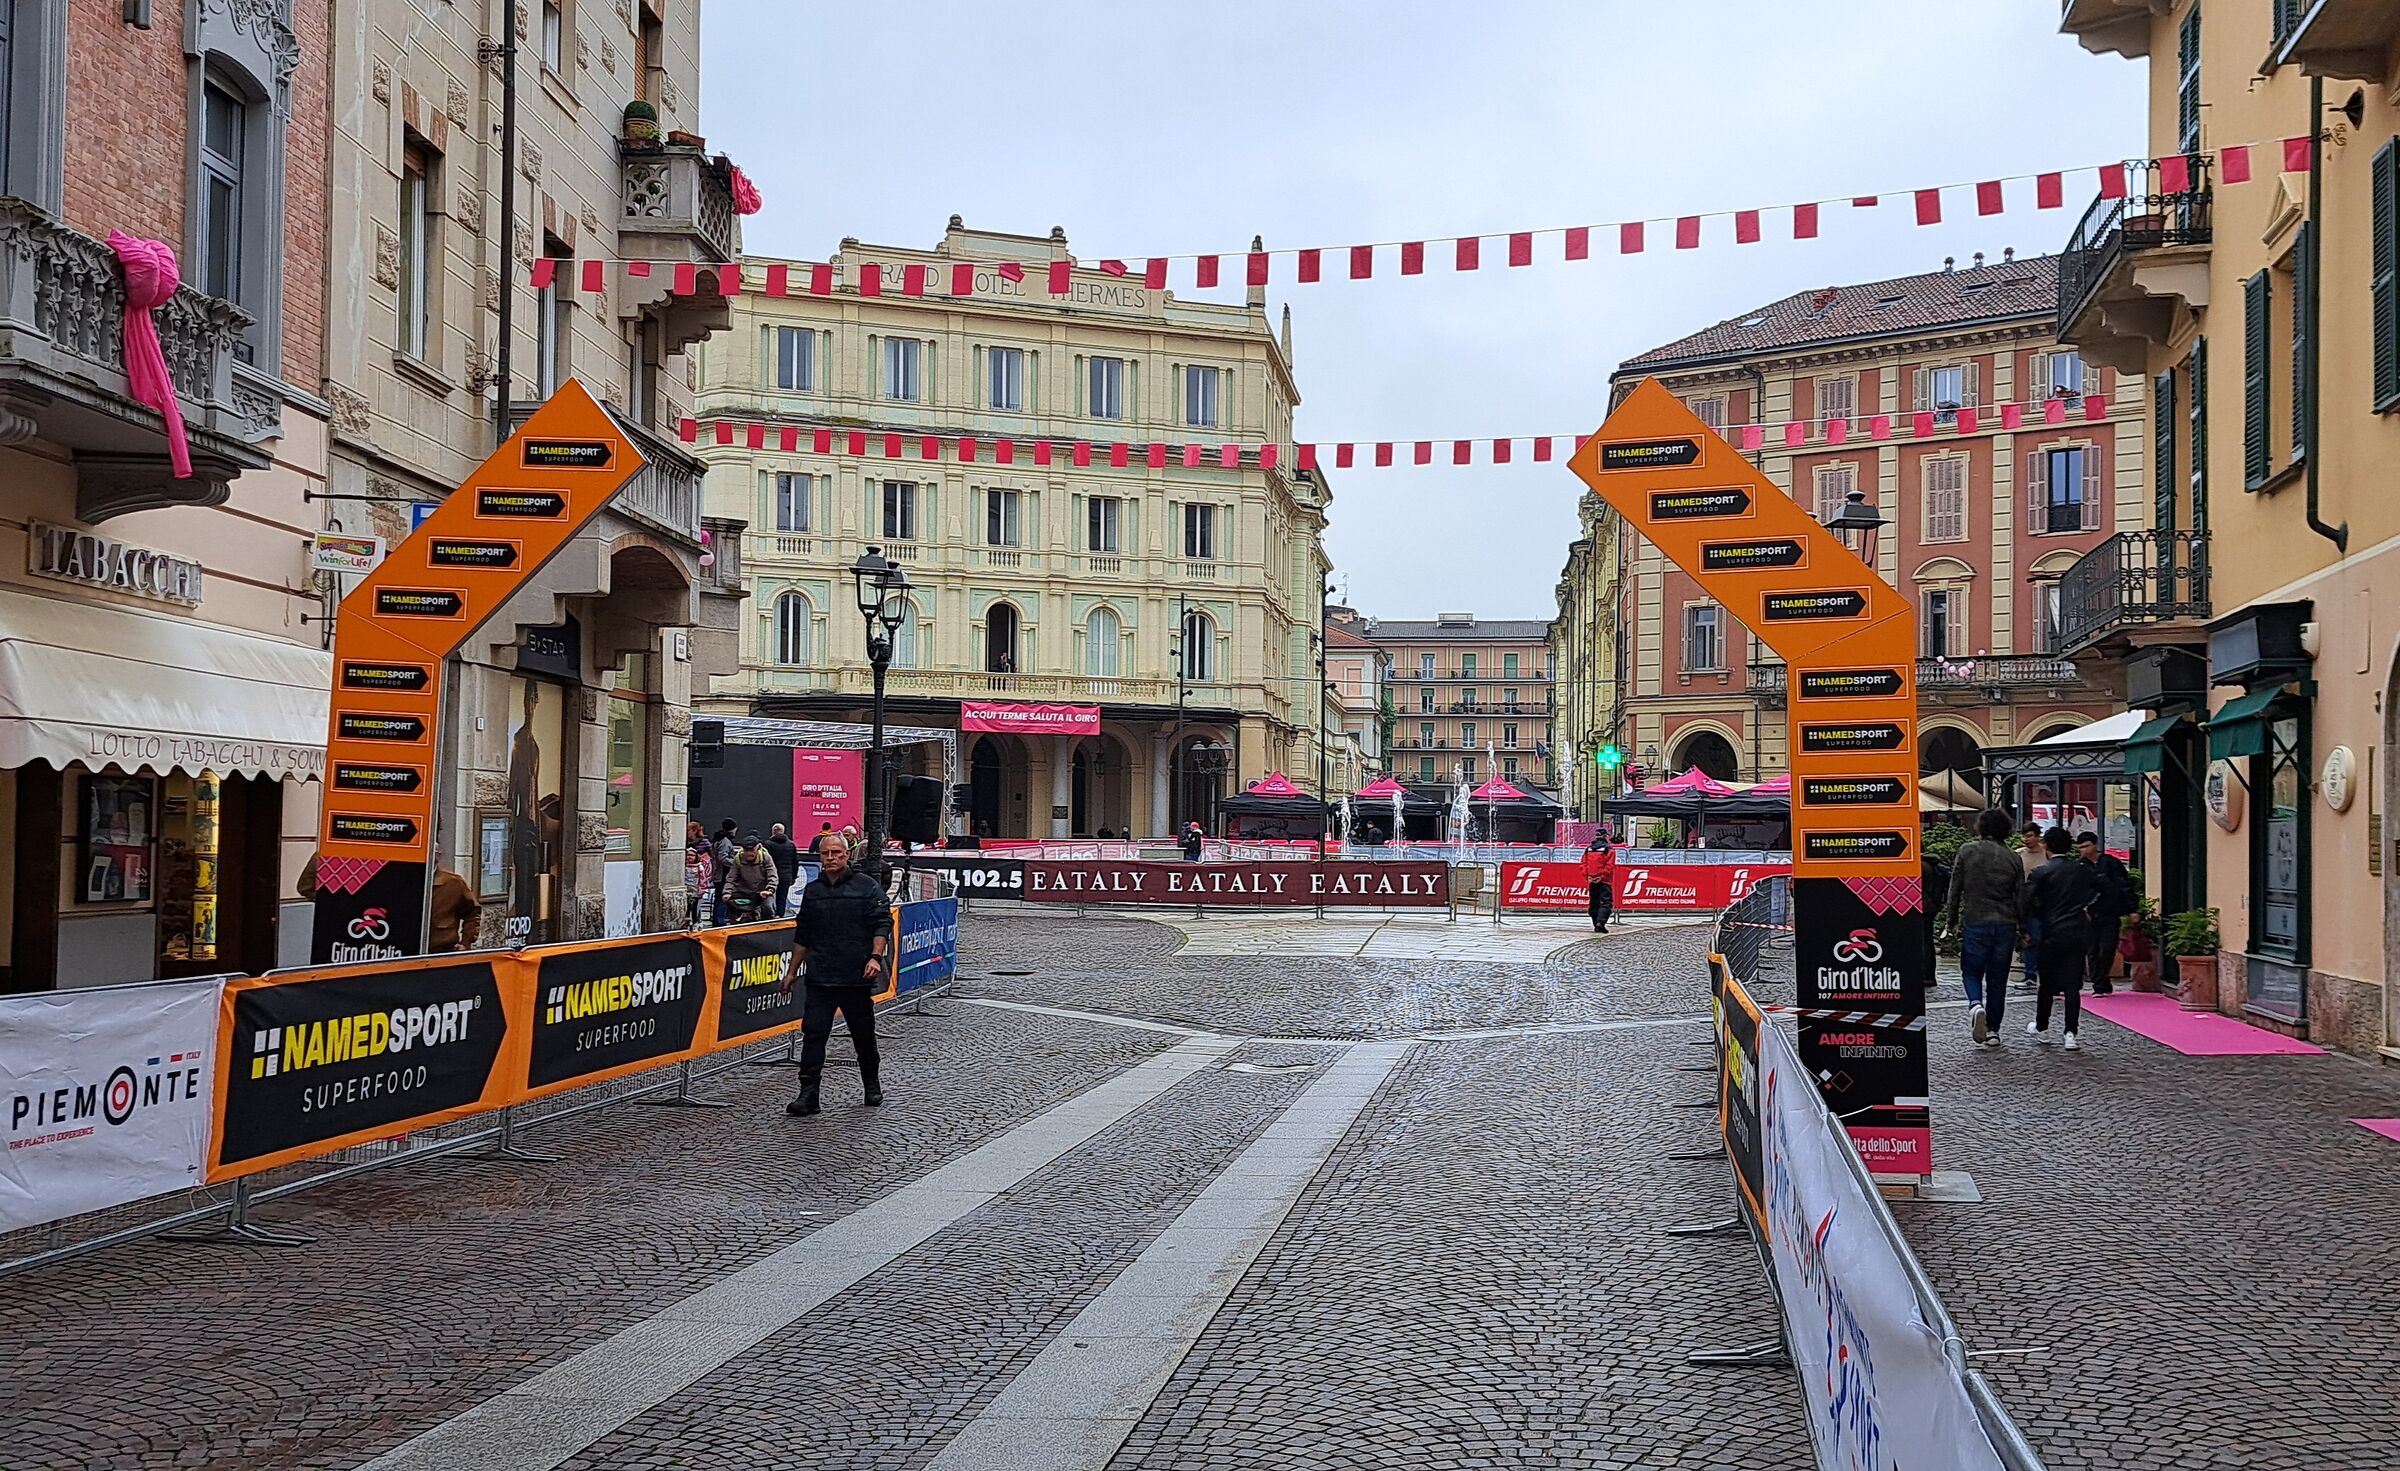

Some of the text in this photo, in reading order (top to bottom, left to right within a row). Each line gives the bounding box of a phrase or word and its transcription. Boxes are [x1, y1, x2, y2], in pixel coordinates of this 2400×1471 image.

[865, 261, 1145, 308] RAD OTEL HERMES
[538, 447, 600, 456] NAMEDSPORT
[1618, 445, 1686, 457] NAMEDSPORT
[492, 496, 554, 506] NAMEDSPORT
[1667, 496, 1736, 507] NAMEDSPORT
[445, 546, 507, 556] NAMEDSPORT
[1719, 546, 1788, 557] NAMEDSPORT
[44, 526, 203, 603] TABACCHI
[390, 595, 451, 605] NAMEDSPORT
[1780, 597, 1851, 608] NAMEDSPORT
[357, 668, 417, 679] NAMEDSPORT
[1816, 675, 1889, 686] NAMEDSPORT
[965, 710, 1097, 723] ACQUI TERME SALUTA IL GIRO
[353, 720, 414, 730] NAMEDSPORT
[1818, 729, 1890, 740] NAMEDSPORT
[91, 732, 160, 758] LOTTO
[270, 748, 281, 768] &
[349, 770, 410, 781] NAMEDSPORT
[1819, 784, 1892, 794] NAMEDSPORT
[345, 821, 406, 832] NAMEDSPORT
[1822, 838, 1896, 848] NAMEDSPORT
[962, 869, 1023, 888] 102.5
[1032, 871, 1147, 891] EATALY
[1167, 873, 1289, 893] EATALY
[1310, 873, 1441, 895] EATALY
[1536, 886, 1590, 897] TRENITAL
[1645, 887, 1696, 897] TRENITALIA
[509, 916, 532, 936] FORD
[331, 941, 402, 962] Giro d'Italia
[1817, 966, 1900, 990] Giro d'Italia
[576, 1018, 656, 1052] SUPERFOOD
[1818, 1033, 1875, 1046] AMORE
[186, 1051, 201, 1060] ITALY
[1840, 1045, 1907, 1059] INFINITO
[302, 1065, 427, 1113] SUPERFOOD
[12, 1066, 200, 1130] PIEMONTE
[9, 1126, 95, 1150] THE PLACE TO EXPERIENCE
[1868, 1137, 1890, 1152] dello
[1891, 1137, 1918, 1155] Sport
